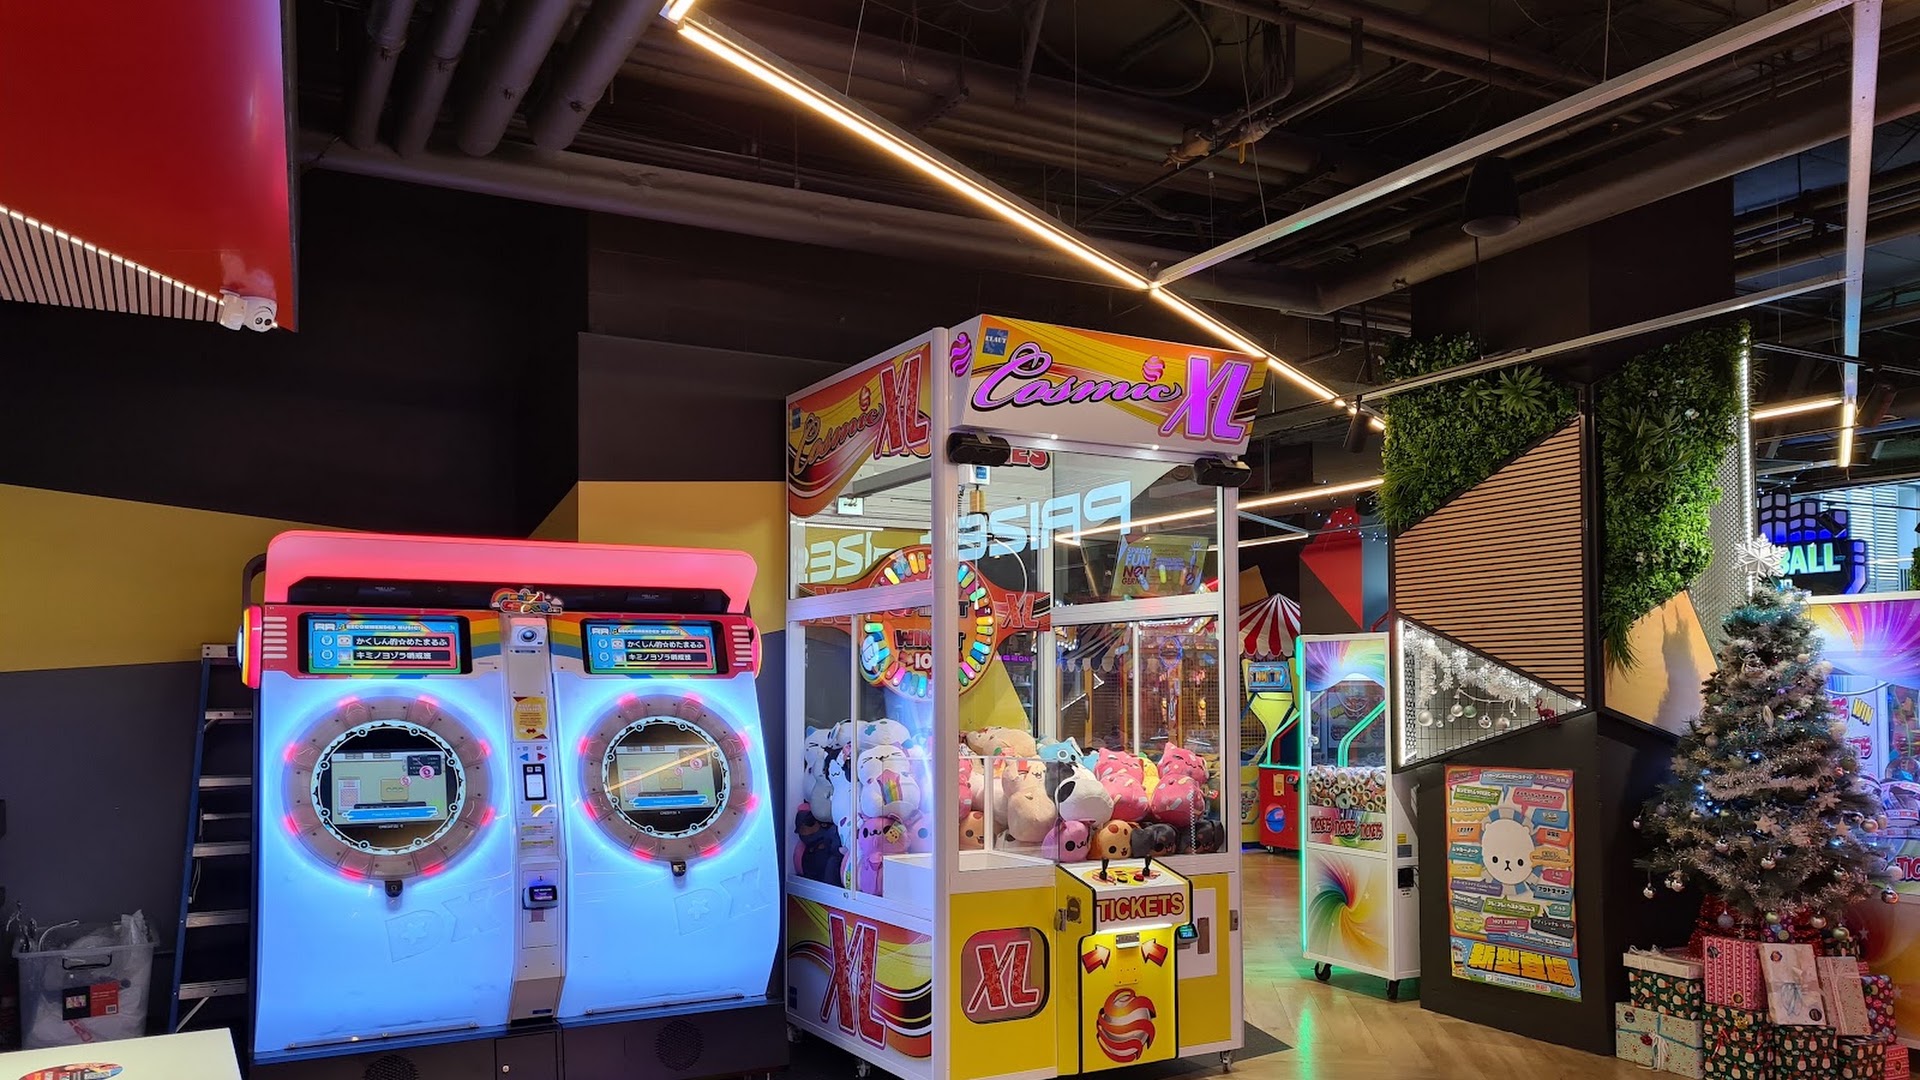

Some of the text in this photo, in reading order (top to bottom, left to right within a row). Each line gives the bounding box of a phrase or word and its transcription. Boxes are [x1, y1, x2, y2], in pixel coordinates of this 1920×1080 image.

[794, 354, 931, 476] Cosmic XL
[971, 342, 1253, 442] Cosmic XL
[1122, 566, 1150, 578] NOT
[1125, 553, 1151, 567] FUN
[1001, 594, 1040, 629] XL
[1097, 892, 1185, 922] TICKETS
[820, 912, 888, 1051] XL
[967, 940, 1040, 1014] XL
